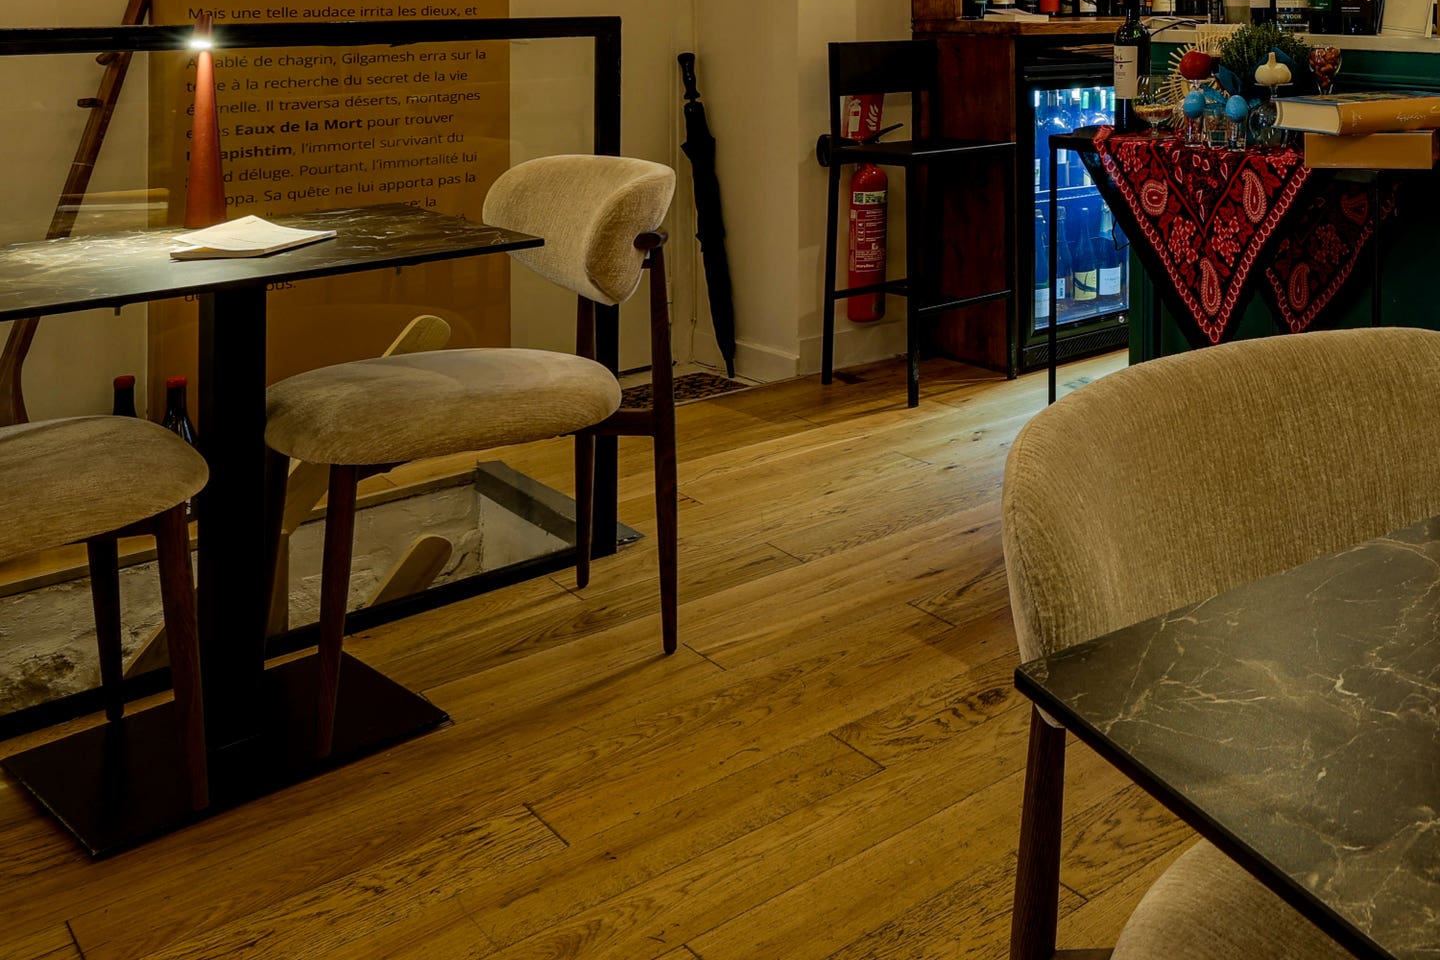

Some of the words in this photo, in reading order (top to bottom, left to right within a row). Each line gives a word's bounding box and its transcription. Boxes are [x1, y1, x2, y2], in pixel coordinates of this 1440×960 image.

[231, 9, 261, 19] une
[266, 6, 298, 18] telle
[302, 6, 355, 17] audace
[360, 6, 393, 16] irrita
[398, 5, 416, 16] les
[420, 5, 460, 16] dieux,
[464, 6, 477, 15] et
[186, 56, 248, 69] Aablé
[253, 55, 273, 67] de
[278, 54, 336, 68] chagrin,
[341, 51, 415, 66] Gilgamesh
[419, 52, 446, 61] erra
[450, 51, 471, 60] sur
[475, 49, 486, 59] la
[231, 78, 240, 91] à
[246, 78, 258, 90] la
[264, 75, 339, 89] recherche
[343, 74, 362, 85] du
[366, 73, 408, 85] secret
[412, 71, 430, 82] de
[434, 71, 445, 81] la
[449, 70, 468, 81] vie
[266, 99, 274, 111] Il
[278, 99, 339, 111] traversa
[344, 95, 401, 107] déserts,
[406, 92, 480, 104] montagnes
[235, 124, 275, 136] Eaux
[279, 121, 300, 133] de
[304, 120, 319, 131] la
[324, 118, 363, 130] Mort
[367, 117, 400, 131] pour
[404, 114, 454, 125] trouver
[380, 134, 443, 148] survivant
[446, 132, 464, 143] du
[238, 167, 294, 181] déluge.
[299, 161, 367, 176] Pourtant,
[462, 151, 477, 162] lui
[263, 190, 282, 201] Sa
[287, 186, 330, 202] quête
[335, 185, 353, 195] ne
[357, 181, 374, 192] lui
[378, 177, 433, 193] apporta
[438, 175, 461, 188] pas
[464, 172, 476, 183] la
[425, 196, 437, 207] la
